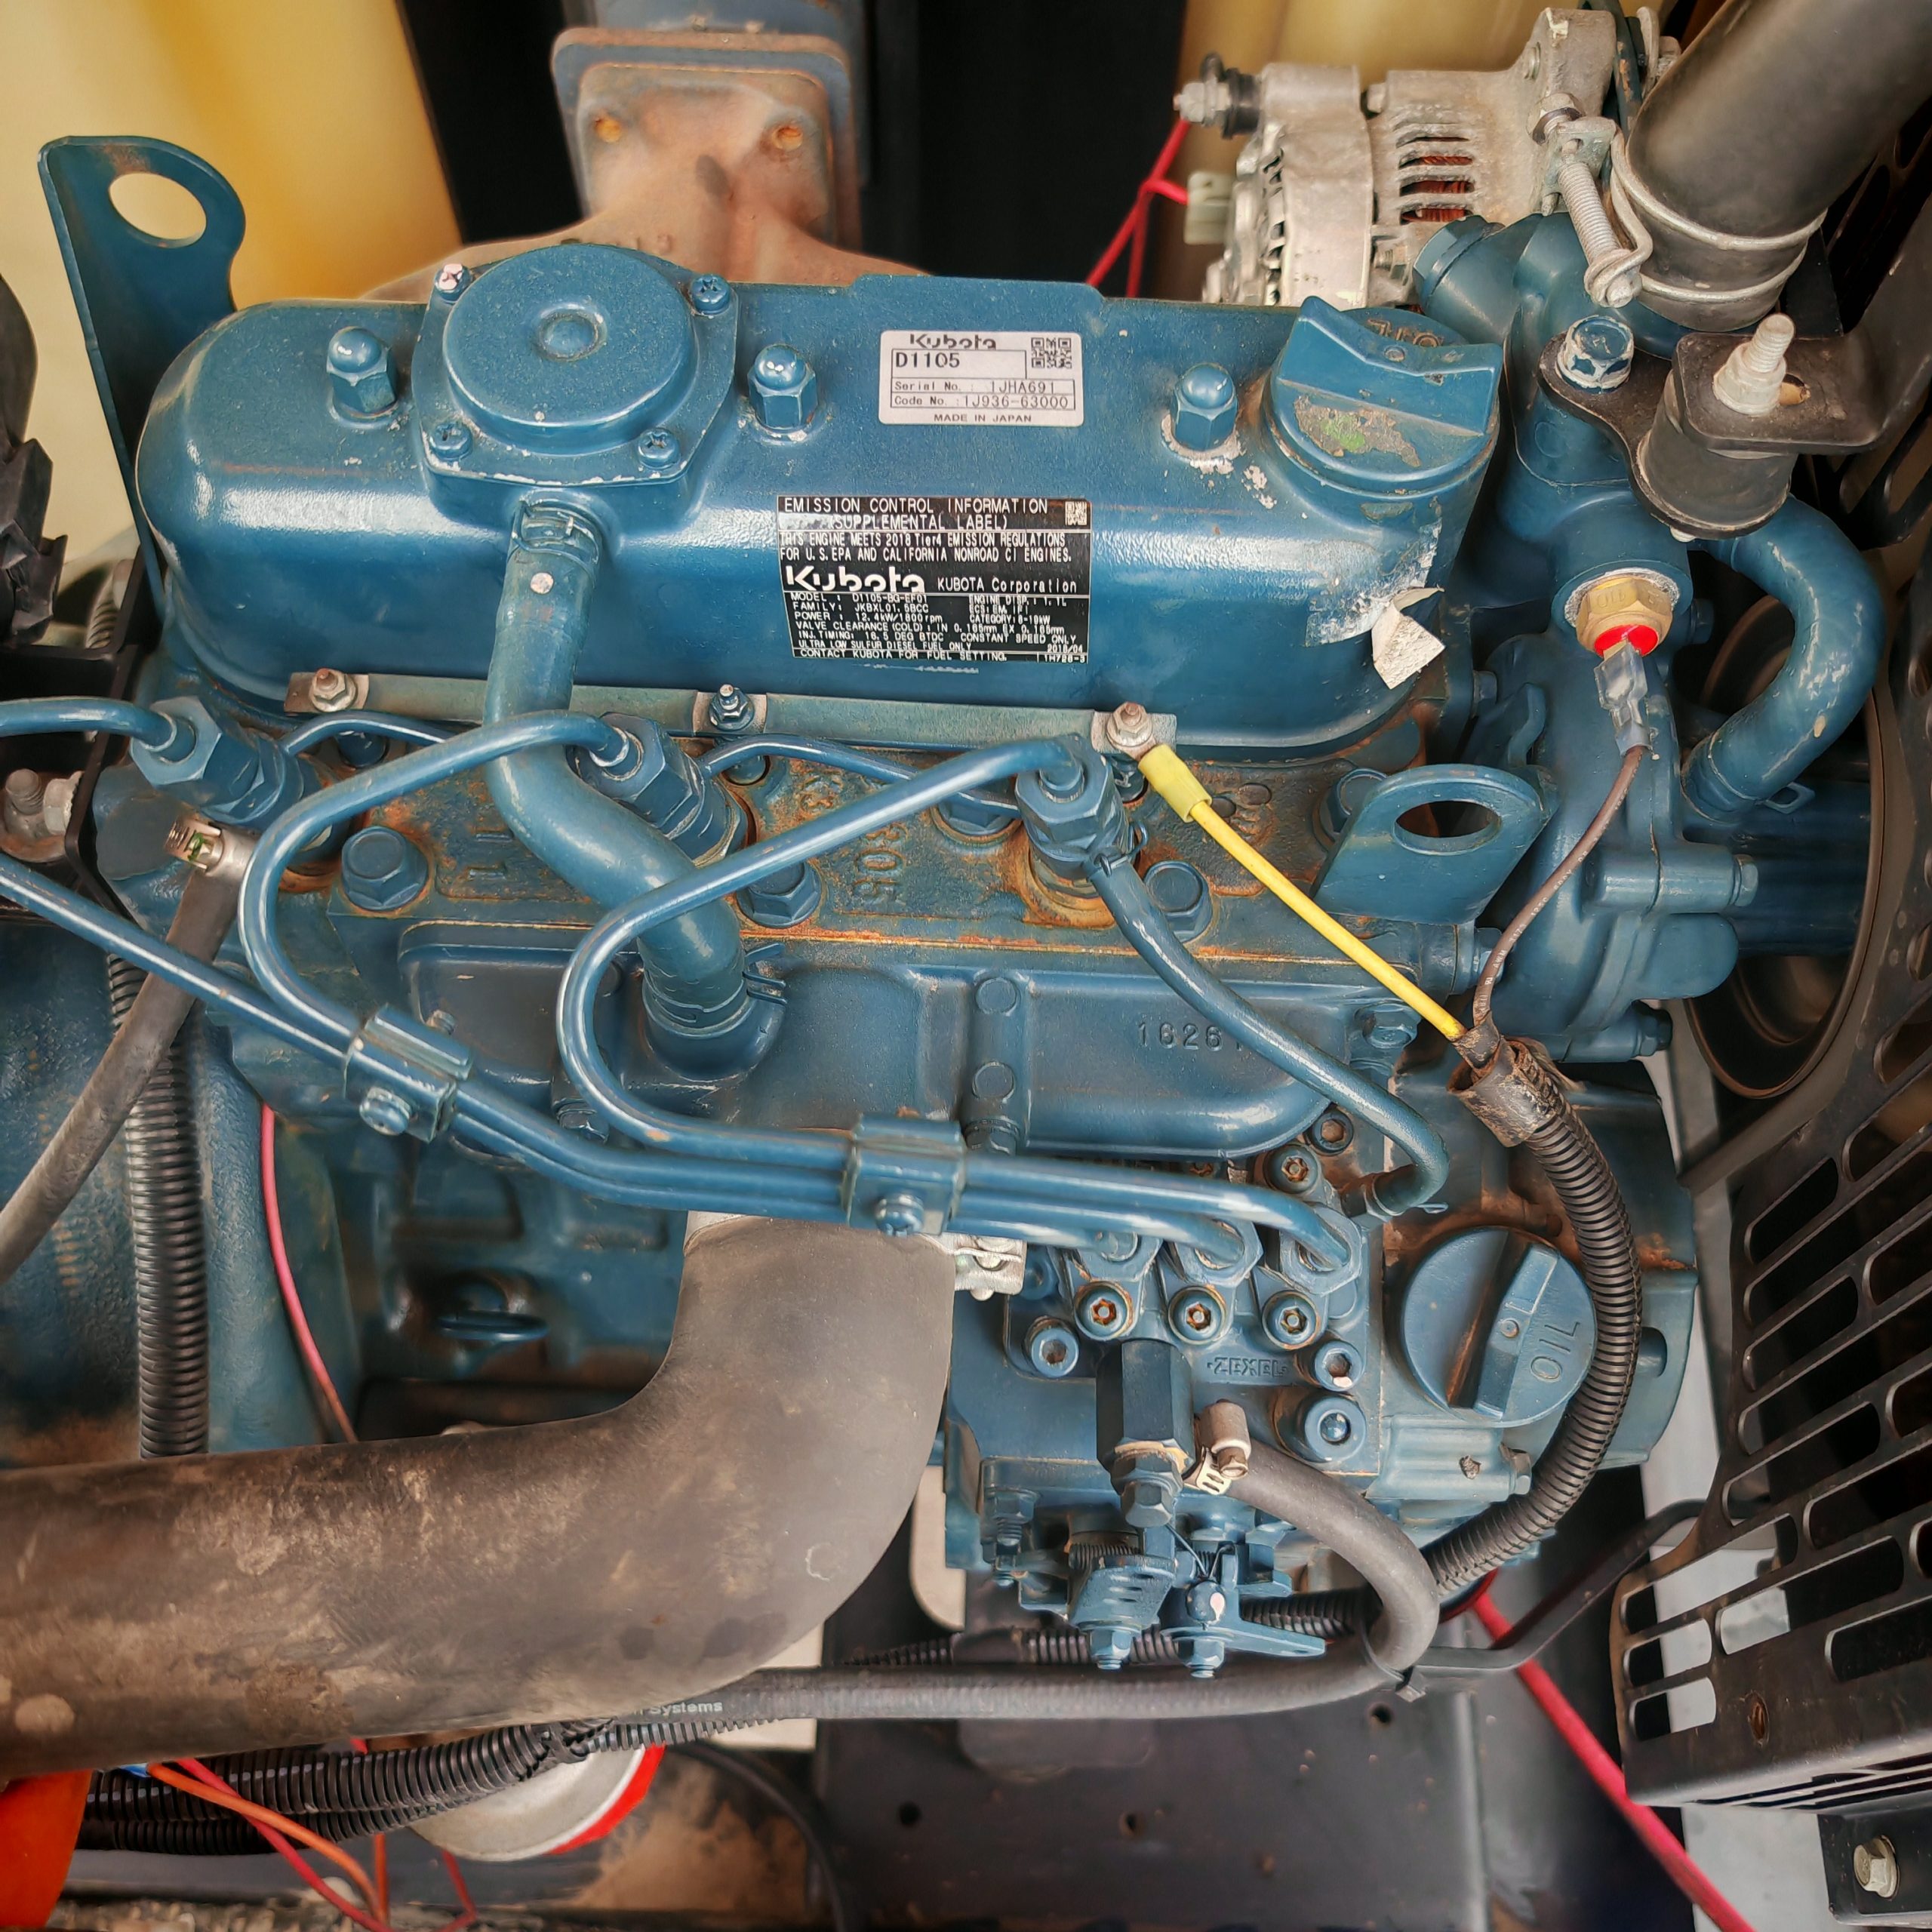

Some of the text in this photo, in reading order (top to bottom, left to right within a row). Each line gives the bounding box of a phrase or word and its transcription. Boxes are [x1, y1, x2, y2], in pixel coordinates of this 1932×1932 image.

[910, 334, 996, 349] Kubota
[896, 352, 960, 368] D1105
[894, 381, 936, 391] Serial
[945, 382, 962, 391] No.
[991, 381, 1055, 394] 1JHA691
[894, 396, 922, 405] Code
[930, 396, 948, 406] No.
[964, 395, 1069, 408] 1J936-63000
[934, 414, 968, 422] MADE
[992, 414, 1032, 423] JAPAN
[785, 497, 1048, 514] EMISSION CONTROL INFORMATION
[829, 515, 1008, 530] (SUPPLEMENTAL LABEL)
[780, 533, 1065, 547] THIS ENGINE MEETS 2018 Tier4 EMISSION REGULATIONS
[780, 548, 800, 561] FOR
[858, 549, 877, 561] AND
[883, 548, 947, 562] CALIFORNIA
[955, 548, 999, 562] NONROAD
[1005, 548, 1017, 562] CI
[1024, 548, 1072, 562] ENGINES.
[786, 566, 925, 592] Kubota
[937, 577, 1076, 594] KUBOTA Corporation
[790, 592, 827, 601] MODEL
[969, 595, 1000, 605] ENGINE
[795, 612, 831, 620] POWER
[795, 621, 827, 630] VALVE
[833, 621, 889, 632] CLEARANCE
[937, 623, 948, 632] IN
[894, 632, 914, 641] DEG
[919, 632, 944, 642] BTDC
[961, 633, 1008, 642] CONSTANT
[1016, 634, 1046, 644] SPEED
[1051, 635, 1076, 645] ONLY
[798, 640, 826, 648] ULTRA
[830, 640, 847, 649] LOW
[851, 640, 882, 649] SULFUR
[887, 641, 918, 650] DIESEL
[923, 641, 943, 650] FUEL
[949, 642, 971, 651] ONLY
[800, 649, 845, 658] CONTACT
[853, 650, 892, 659] KUBOTA
[899, 651, 918, 660] FOR
[927, 651, 952, 660] FUEL
[1531, 1321, 1580, 1382] OIL
[651, 1701, 723, 1718] Systems
